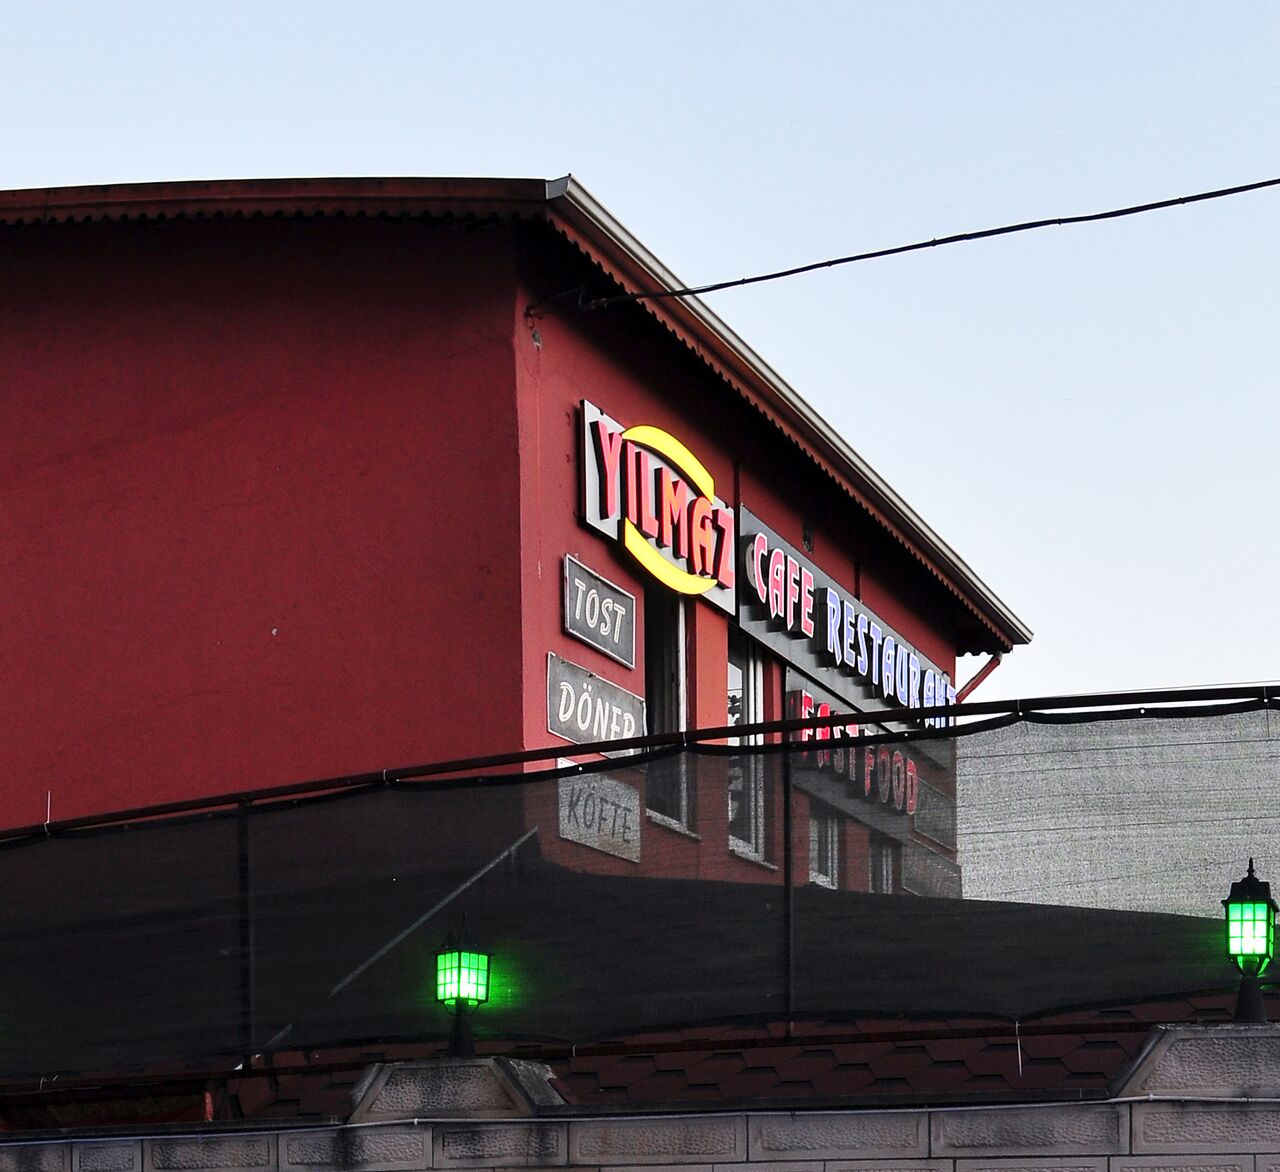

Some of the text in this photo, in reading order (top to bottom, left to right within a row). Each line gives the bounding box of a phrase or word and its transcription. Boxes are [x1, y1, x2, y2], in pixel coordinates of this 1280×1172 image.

[591, 421, 733, 588] YILMAZ
[574, 579, 626, 644] TOST
[753, 532, 814, 638] CAFE
[567, 784, 632, 844] KÖFTE
[864, 726, 918, 815] FOOD
